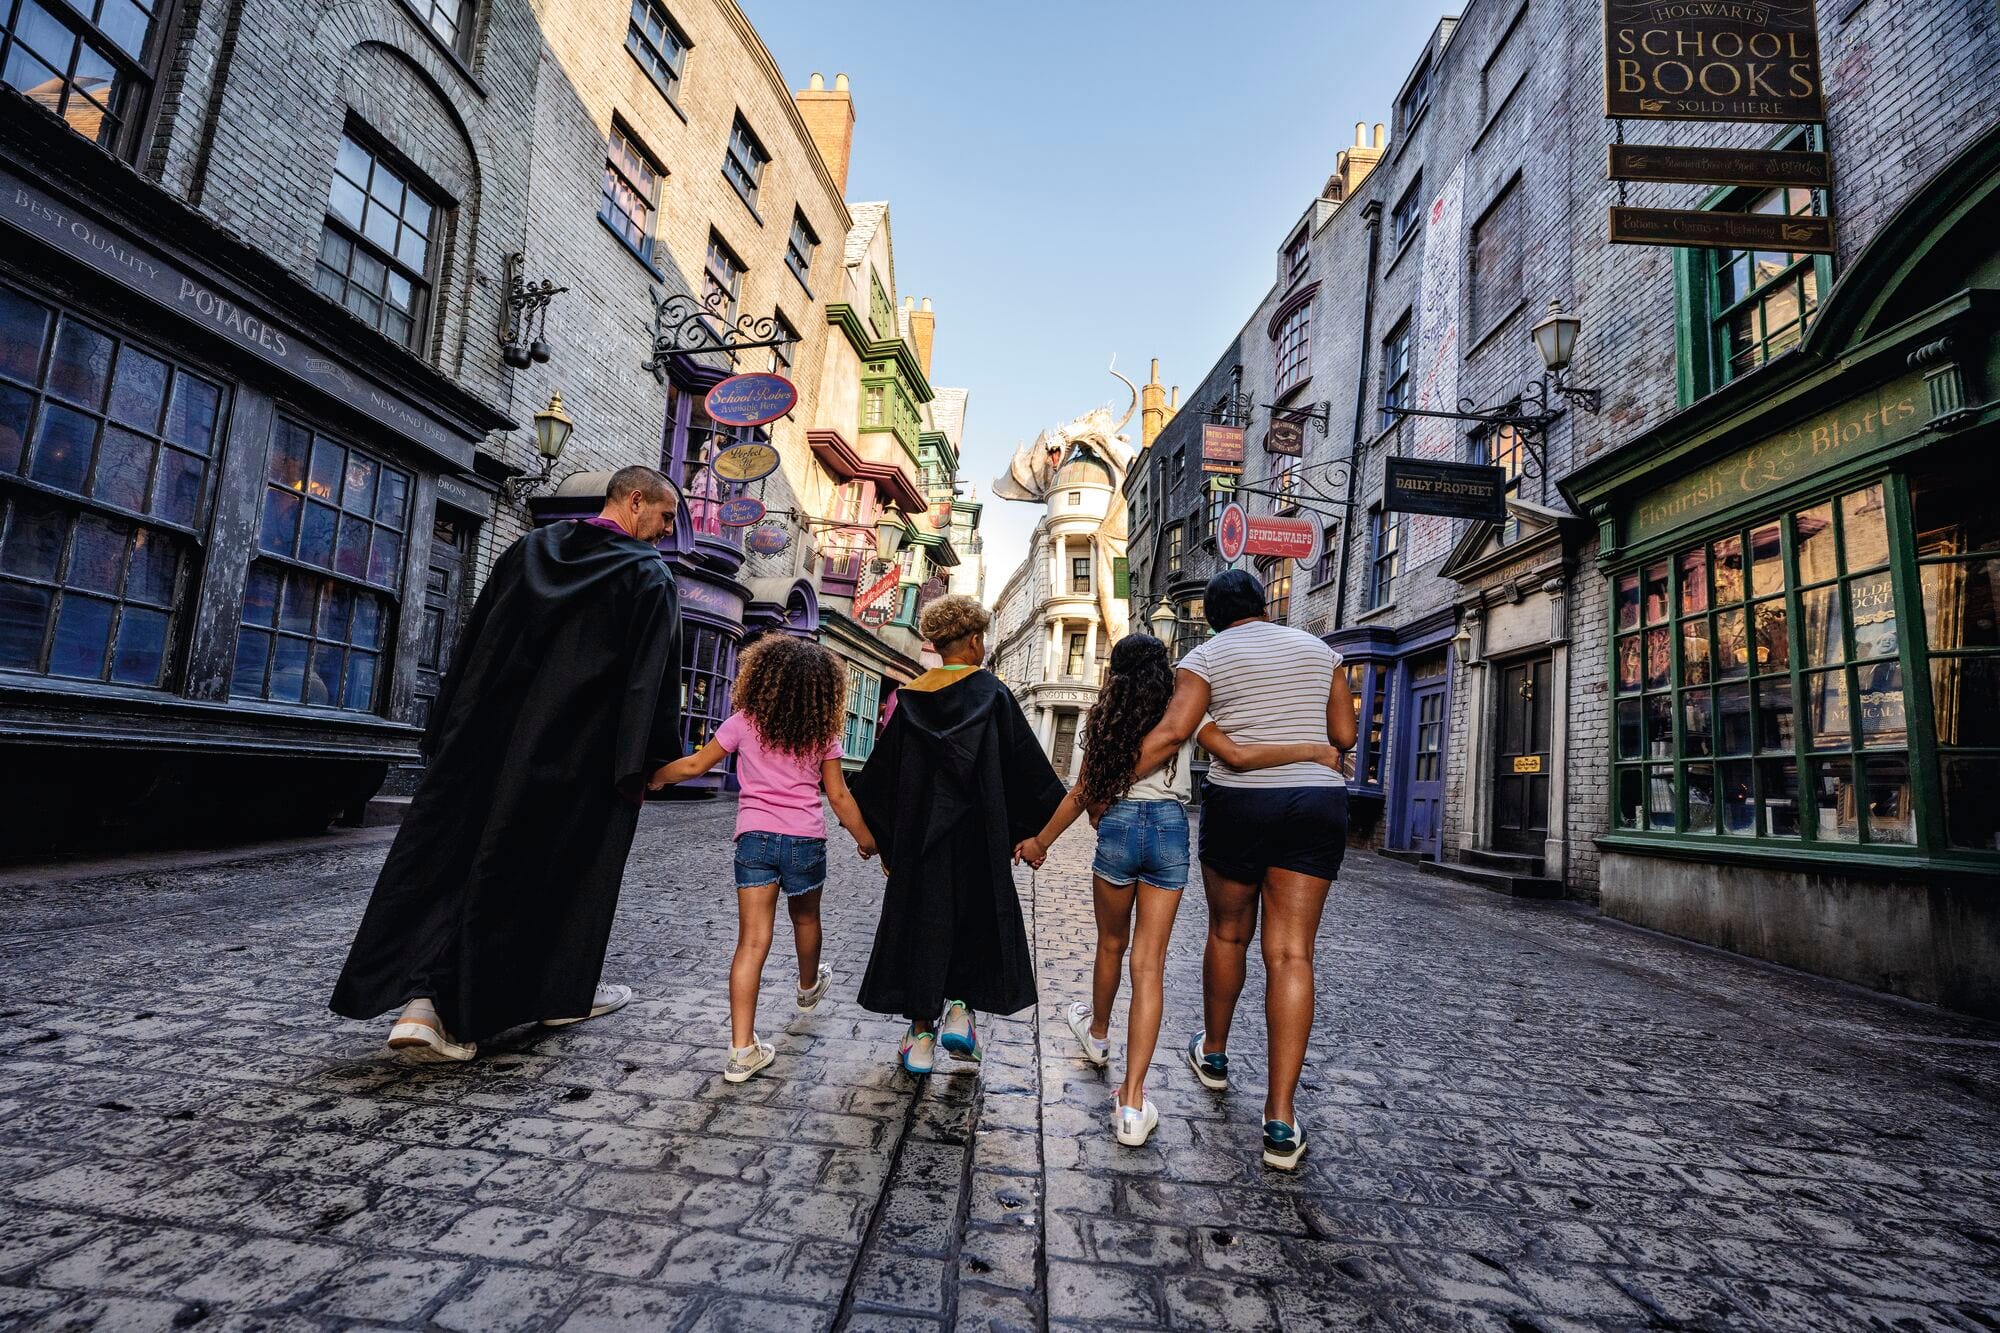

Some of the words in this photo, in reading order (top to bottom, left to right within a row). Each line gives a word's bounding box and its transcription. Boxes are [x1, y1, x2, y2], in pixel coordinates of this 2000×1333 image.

[1655, 3, 1765, 24] HOGWARTS
[1617, 28, 1811, 59] SCHOOL
[1616, 59, 1814, 98] BOOKS
[1676, 100, 1725, 114] SOLD
[1732, 101, 1784, 114] HERE
[14, 189, 69, 228] BEST
[71, 222, 160, 280] QUALITY
[710, 389, 753, 405] School
[753, 386, 792, 401] Robes
[760, 401, 778, 410] Here
[370, 391, 397, 414] NEW
[398, 410, 421, 428] AND
[423, 422, 448, 442] USED
[730, 447, 765, 459] Perfect
[1638, 477, 1722, 530] Flourish
[1810, 397, 1916, 457] Blotts
[438, 479, 466, 497] DRONS
[1395, 478, 1434, 491] DAILY
[1434, 481, 1494, 497] PROPHET
[1248, 529, 1312, 545] SPINDLEWARPS
[1481, 569, 1504, 588] DAILY
[1504, 553, 1546, 580] PROPHET
